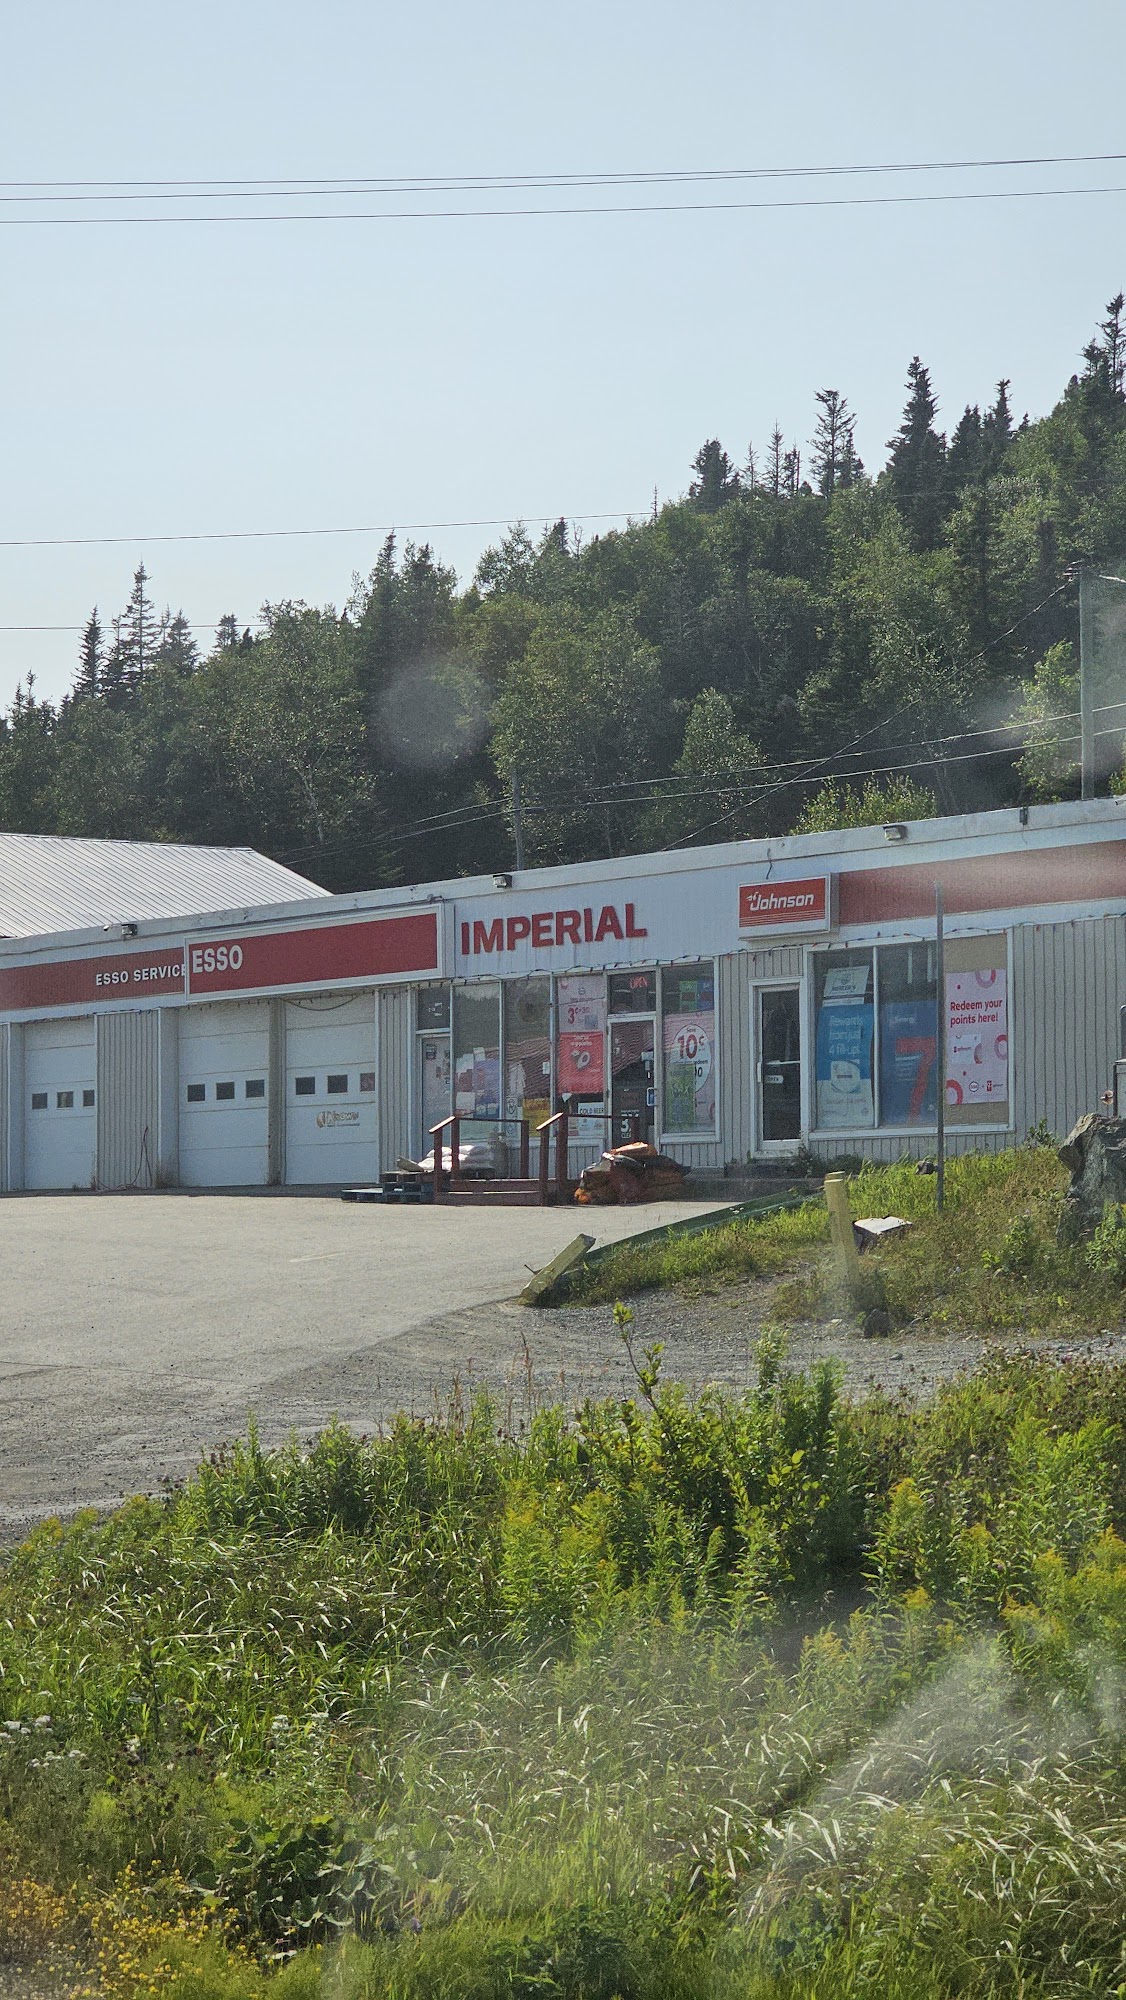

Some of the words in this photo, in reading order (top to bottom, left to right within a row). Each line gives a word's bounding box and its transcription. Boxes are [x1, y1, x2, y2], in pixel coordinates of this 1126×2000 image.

[749, 892, 815, 912] Johnson
[461, 902, 648, 955] IMPERIAL
[192, 944, 243, 974] ESSO
[95, 970, 129, 986] ESSO
[950, 1000, 983, 1011] Redeem
[984, 999, 1003, 1012] your
[950, 1013, 977, 1028] points
[977, 1011, 999, 1024] here!
